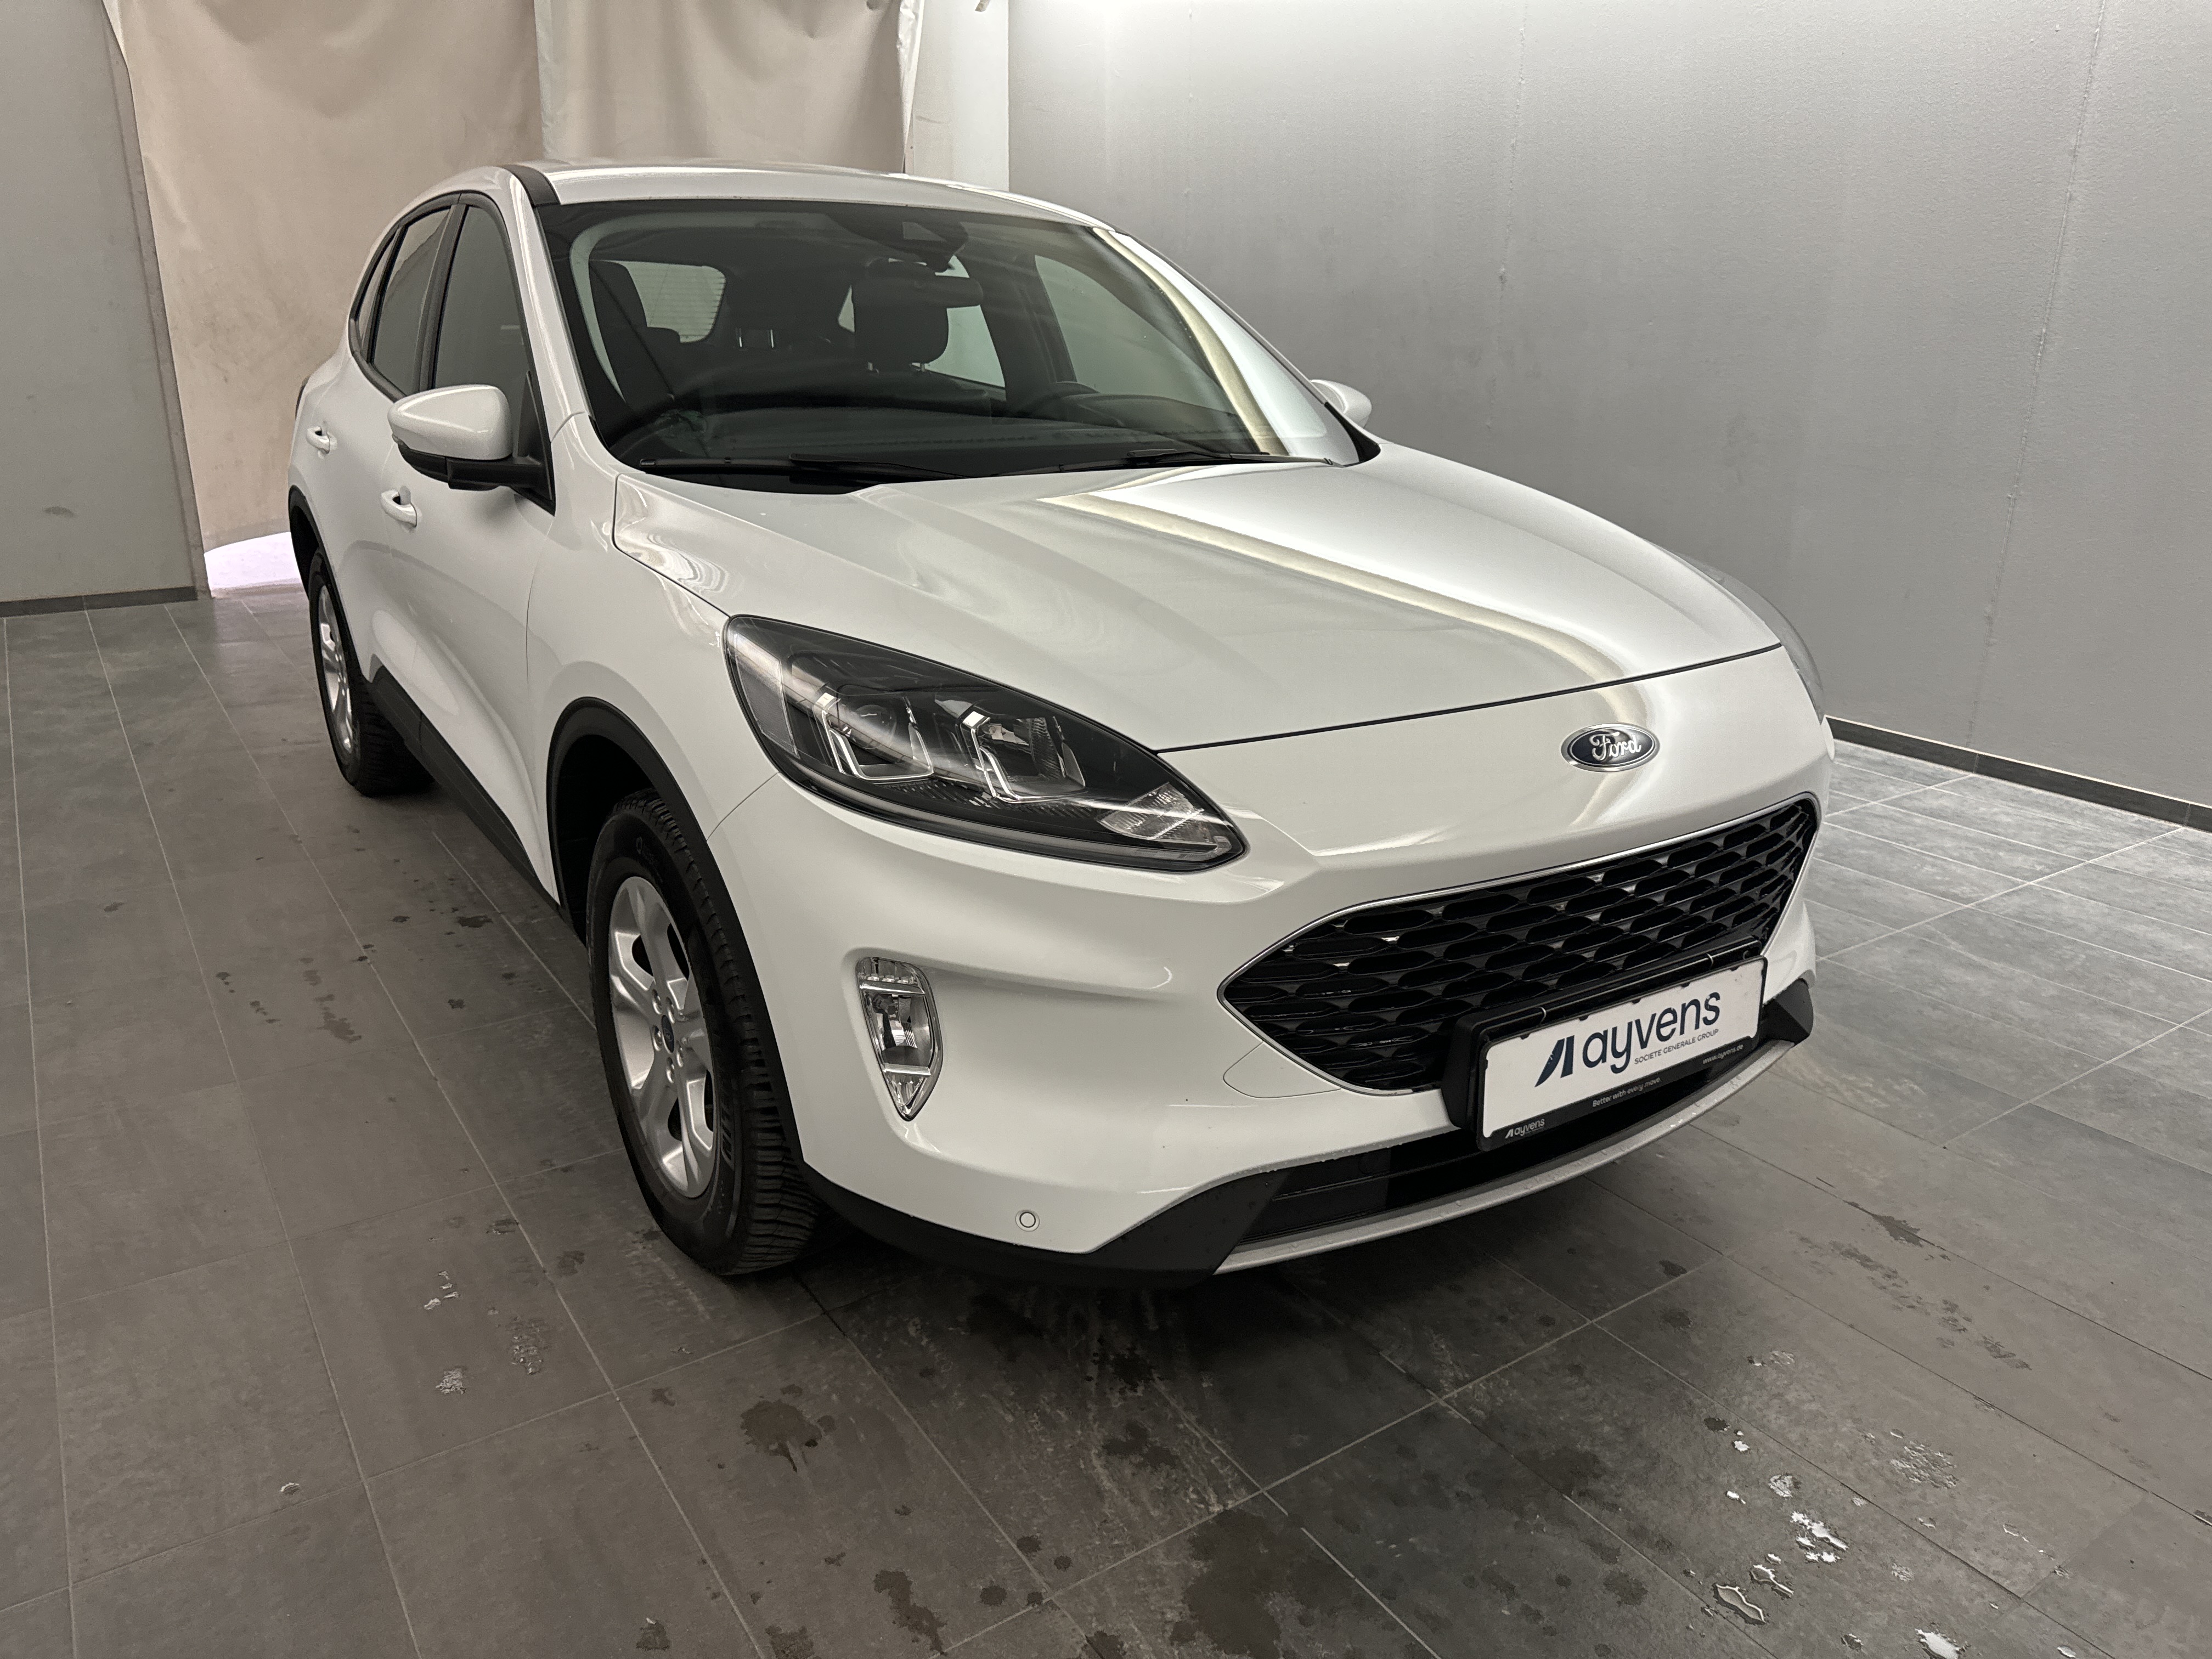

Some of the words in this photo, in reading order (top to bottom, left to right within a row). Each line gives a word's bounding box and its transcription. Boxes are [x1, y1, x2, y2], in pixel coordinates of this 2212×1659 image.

[1589, 731, 1641, 761] Ford
[1582, 992, 1720, 1074] ayvens
[1634, 1049, 1662, 1065] SOCIETE
[1663, 1037, 1696, 1054] GENERALE
[1697, 1028, 1719, 1041] GROUP
[1592, 1095, 1612, 1108] Better
[1612, 1089, 1627, 1100] with
[1627, 1084, 1644, 1094] every
[1514, 1118, 1545, 1137] ayvens
